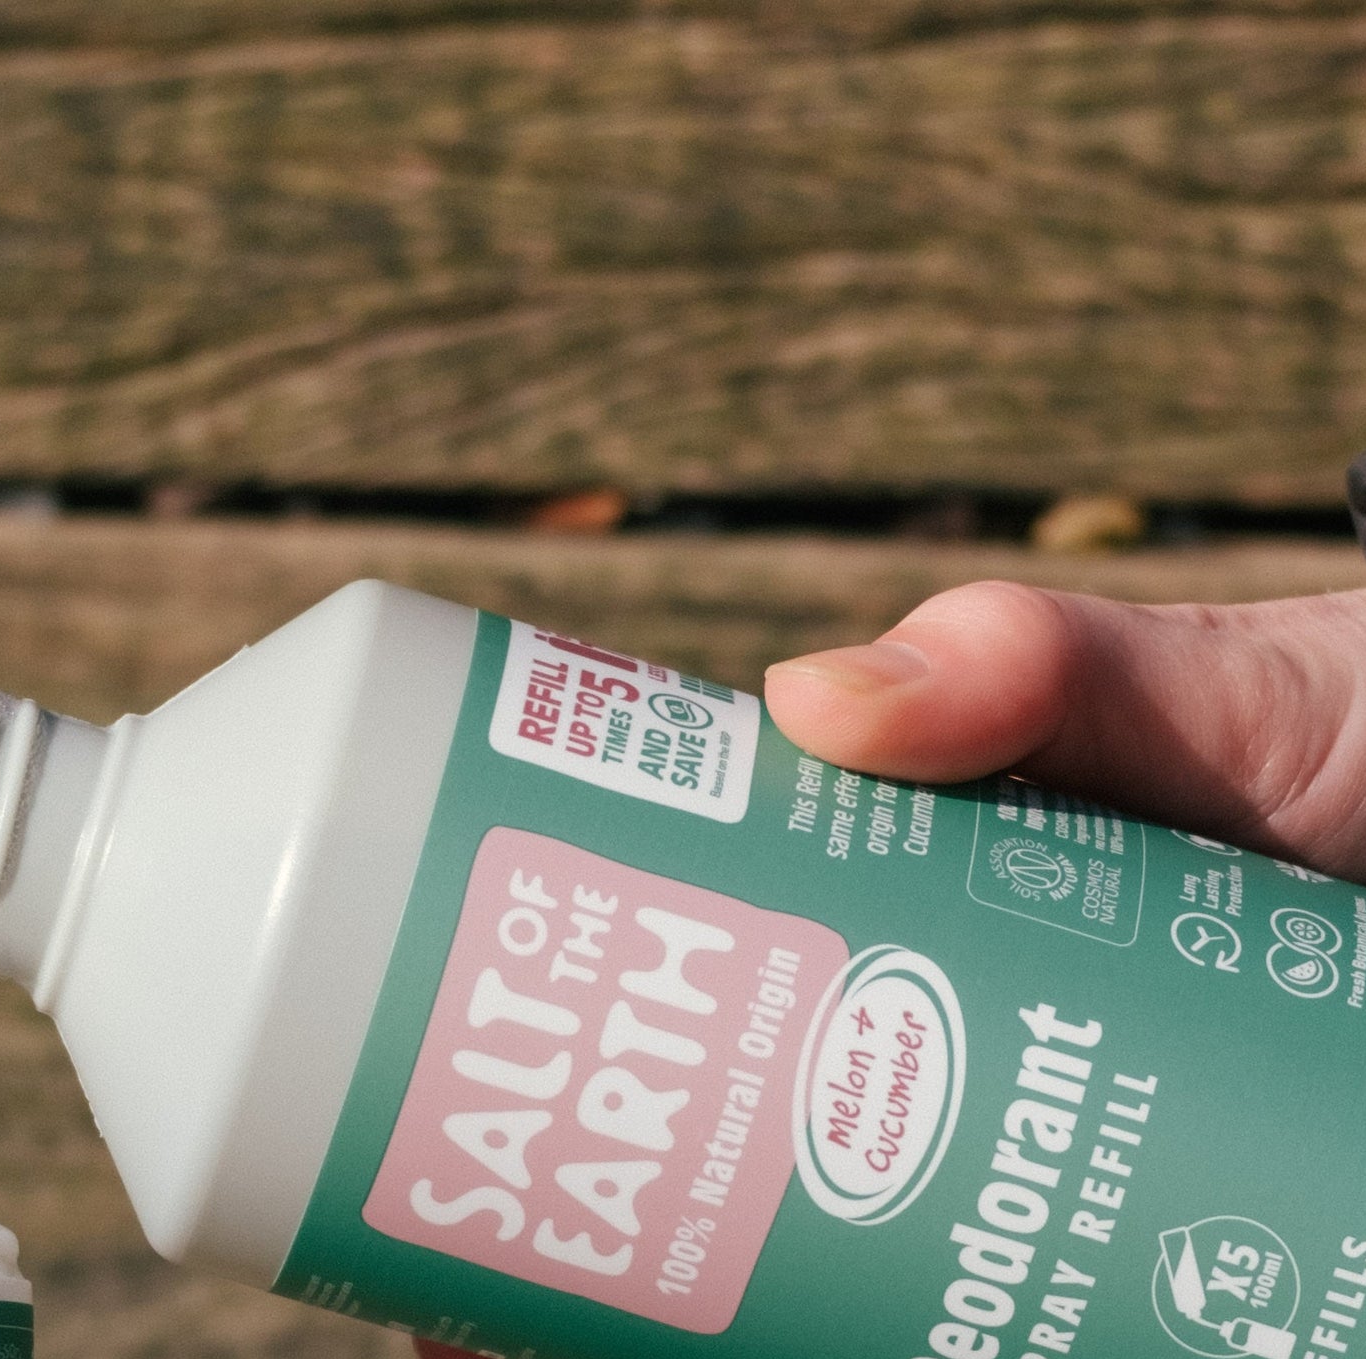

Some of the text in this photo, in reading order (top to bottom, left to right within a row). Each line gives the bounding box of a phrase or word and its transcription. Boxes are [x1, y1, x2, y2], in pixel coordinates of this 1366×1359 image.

[518, 658, 569, 746] REFILL
[565, 669, 640, 757] UP TO 5
[601, 708, 633, 763] TIMES
[637, 728, 672, 781] AND
[670, 731, 707, 790] SAVE
[710, 771, 725, 798] Based
[718, 759, 727, 771] on
[787, 756, 823, 833] This Refill
[826, 770, 861, 860] same effec
[866, 805, 897, 856] origin
[902, 792, 935, 857] Cucumbe
[989, 837, 1048, 878] ASSOCIATION
[1049, 853, 1079, 901] NATURAL
[1010, 880, 1041, 902] SOIL
[1081, 858, 1105, 920] COSMOS
[1098, 867, 1122, 926] NATURAL
[1180, 873, 1201, 903] Long
[1202, 869, 1224, 911] Lasting
[1226, 865, 1243, 918] Protection
[550, 883, 619, 986] THE
[1347, 970, 1366, 1008] Fresh
[410, 966, 582, 1241] SALT
[497, 867, 559, 956] OF
[533, 906, 734, 1277] EARTH
[656, 947, 802, 1297] 100% Natural Origin
[1068, 1073, 1158, 1245] REFILL
[1205, 1239, 1261, 1302] X5
[1249, 1250, 1284, 1311] 100ml
